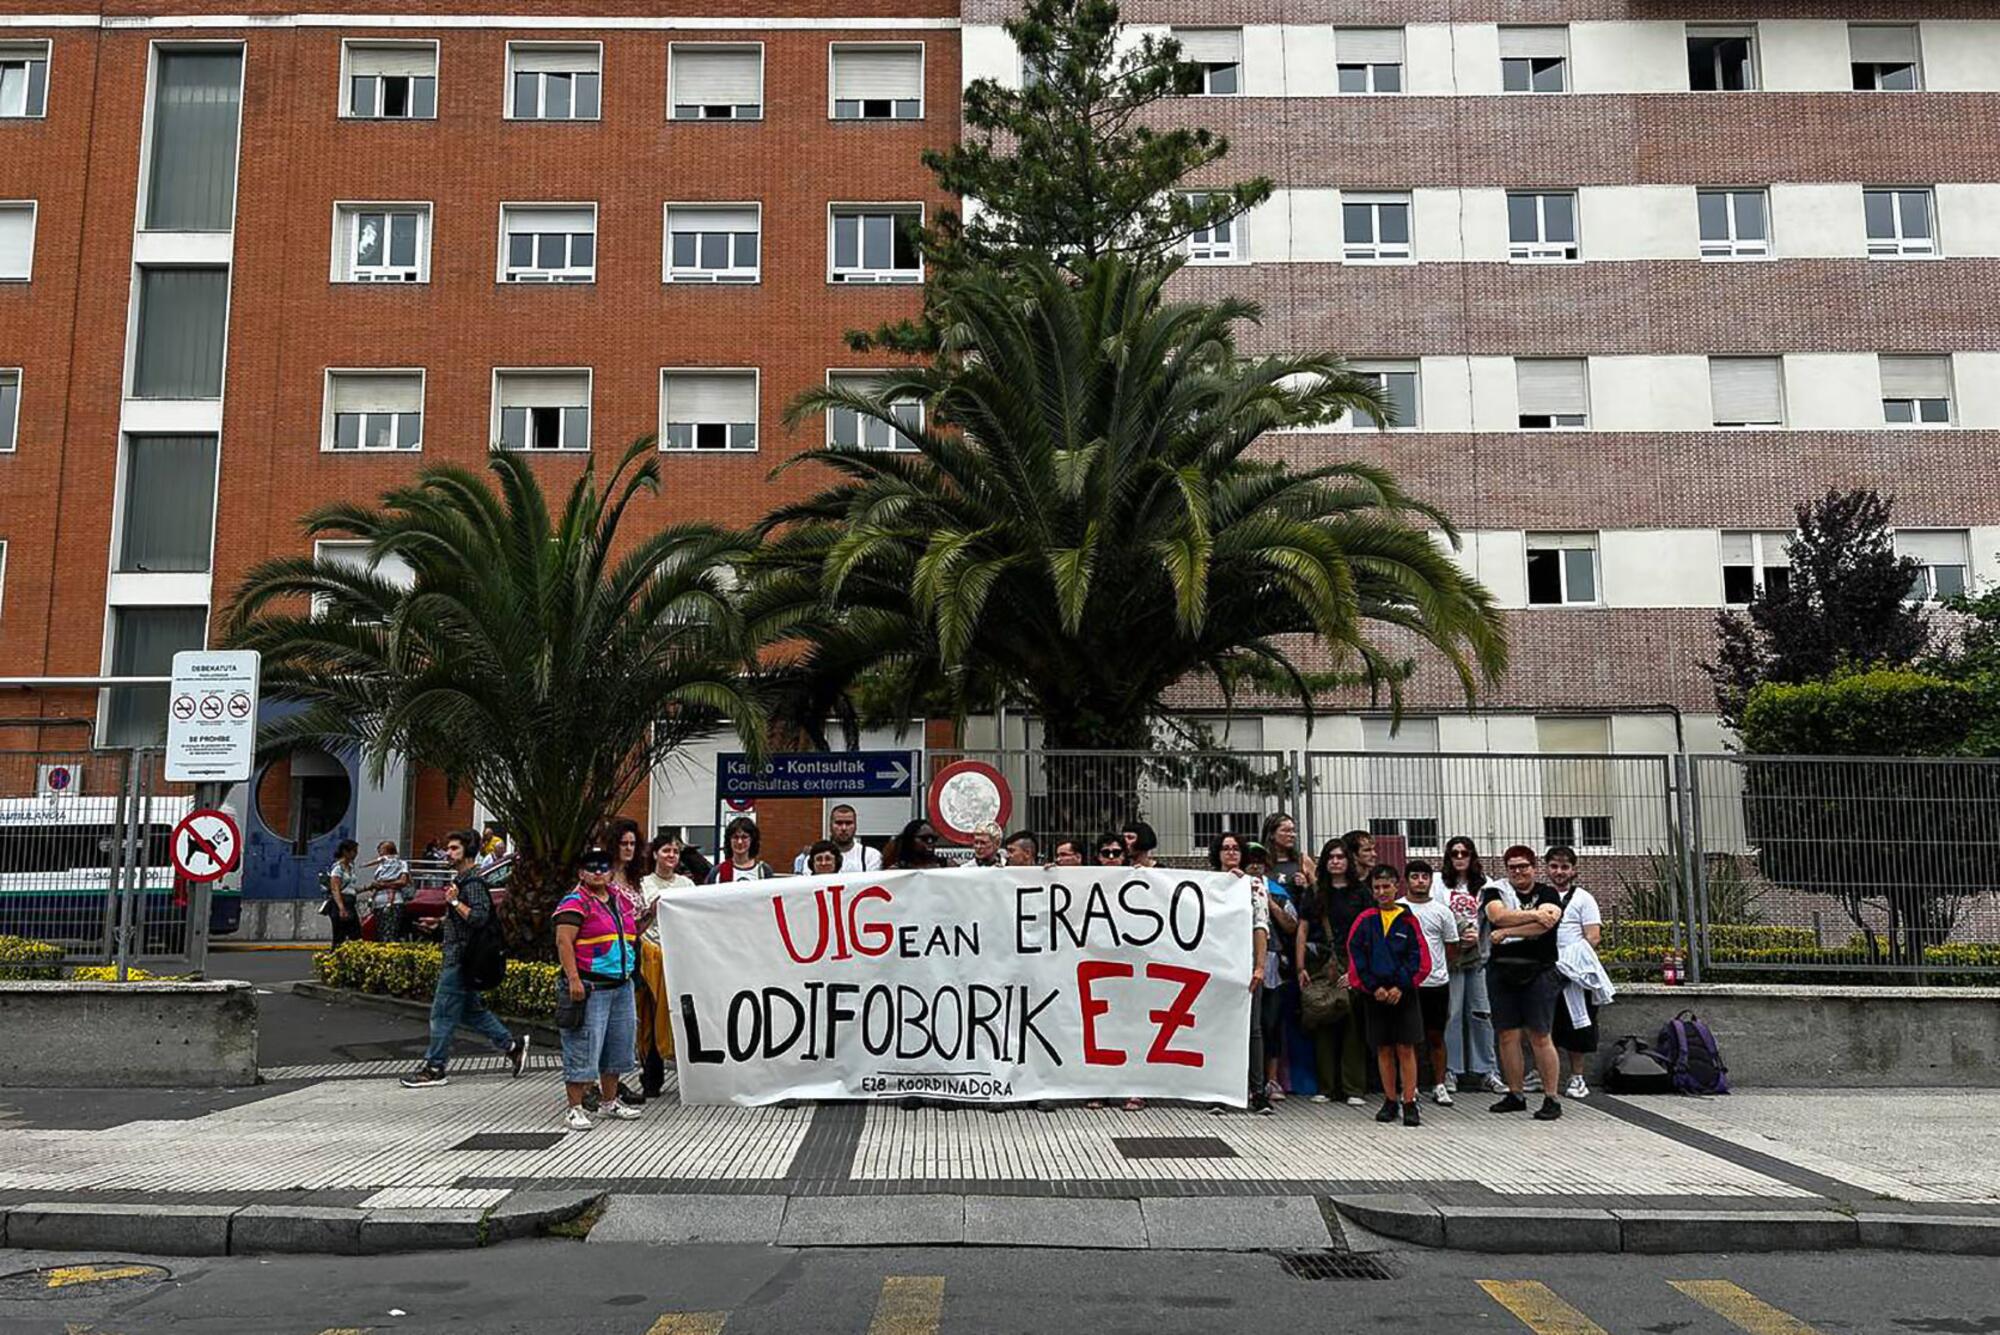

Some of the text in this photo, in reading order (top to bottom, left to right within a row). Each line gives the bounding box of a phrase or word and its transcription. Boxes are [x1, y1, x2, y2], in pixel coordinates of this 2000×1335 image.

[787, 760, 865, 774] Kontsultak
[727, 777, 865, 791] Consultas externas
[1016, 880, 1206, 954] ERASO
[680, 961, 1212, 1067] LODIFOBORIK EZ
[861, 1077, 1013, 1096] E28 KOORDINADORA
